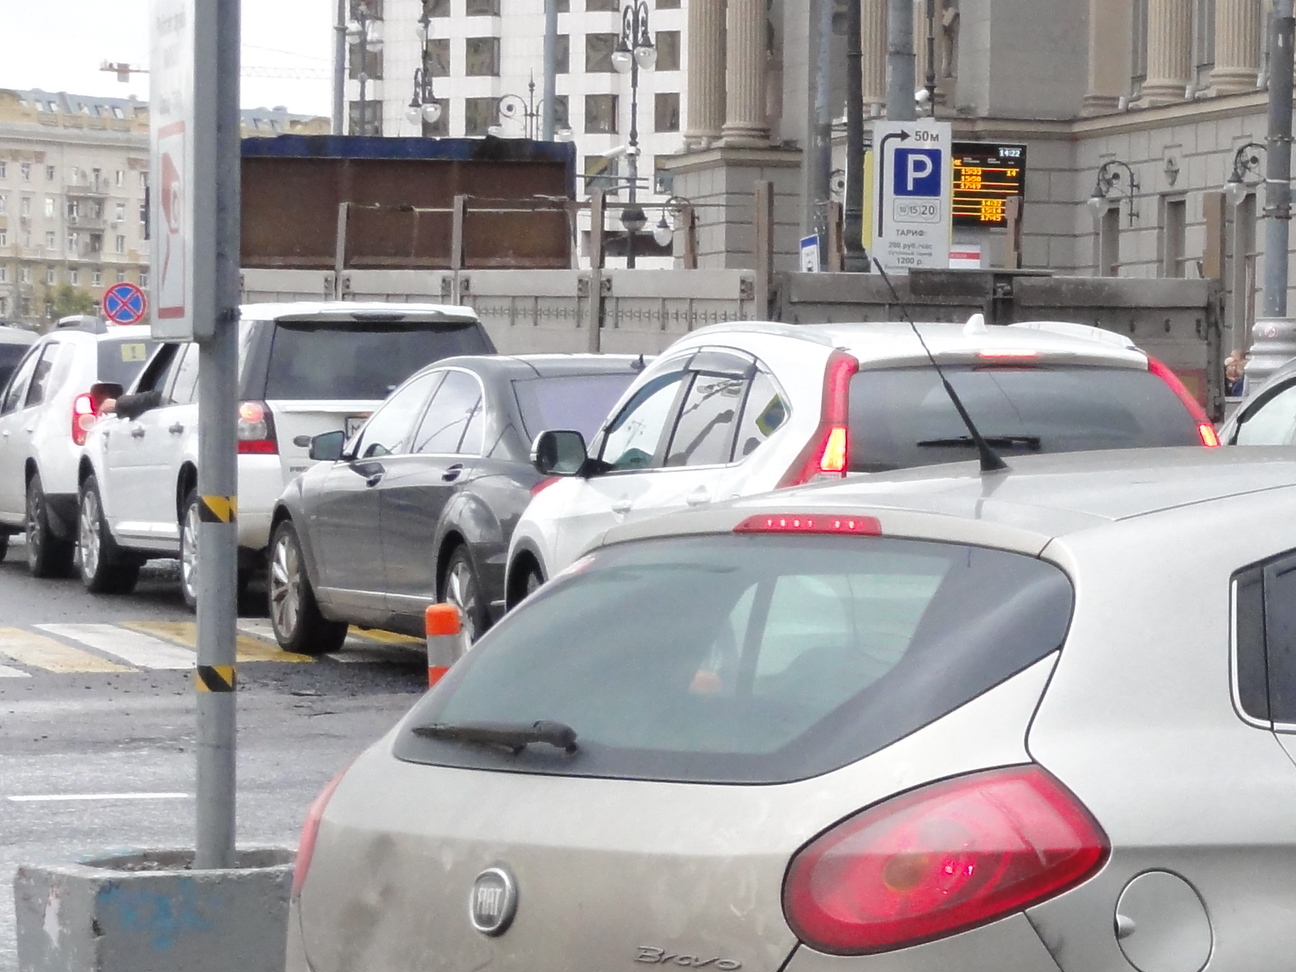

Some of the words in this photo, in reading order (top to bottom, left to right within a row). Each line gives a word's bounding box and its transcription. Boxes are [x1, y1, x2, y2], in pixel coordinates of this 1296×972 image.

[914, 130, 939, 142] 50м
[921, 205, 935, 216] 20
[897, 257, 915, 265] 1200
[477, 887, 503, 916] FIAT
[634, 946, 742, 971] Bravo
